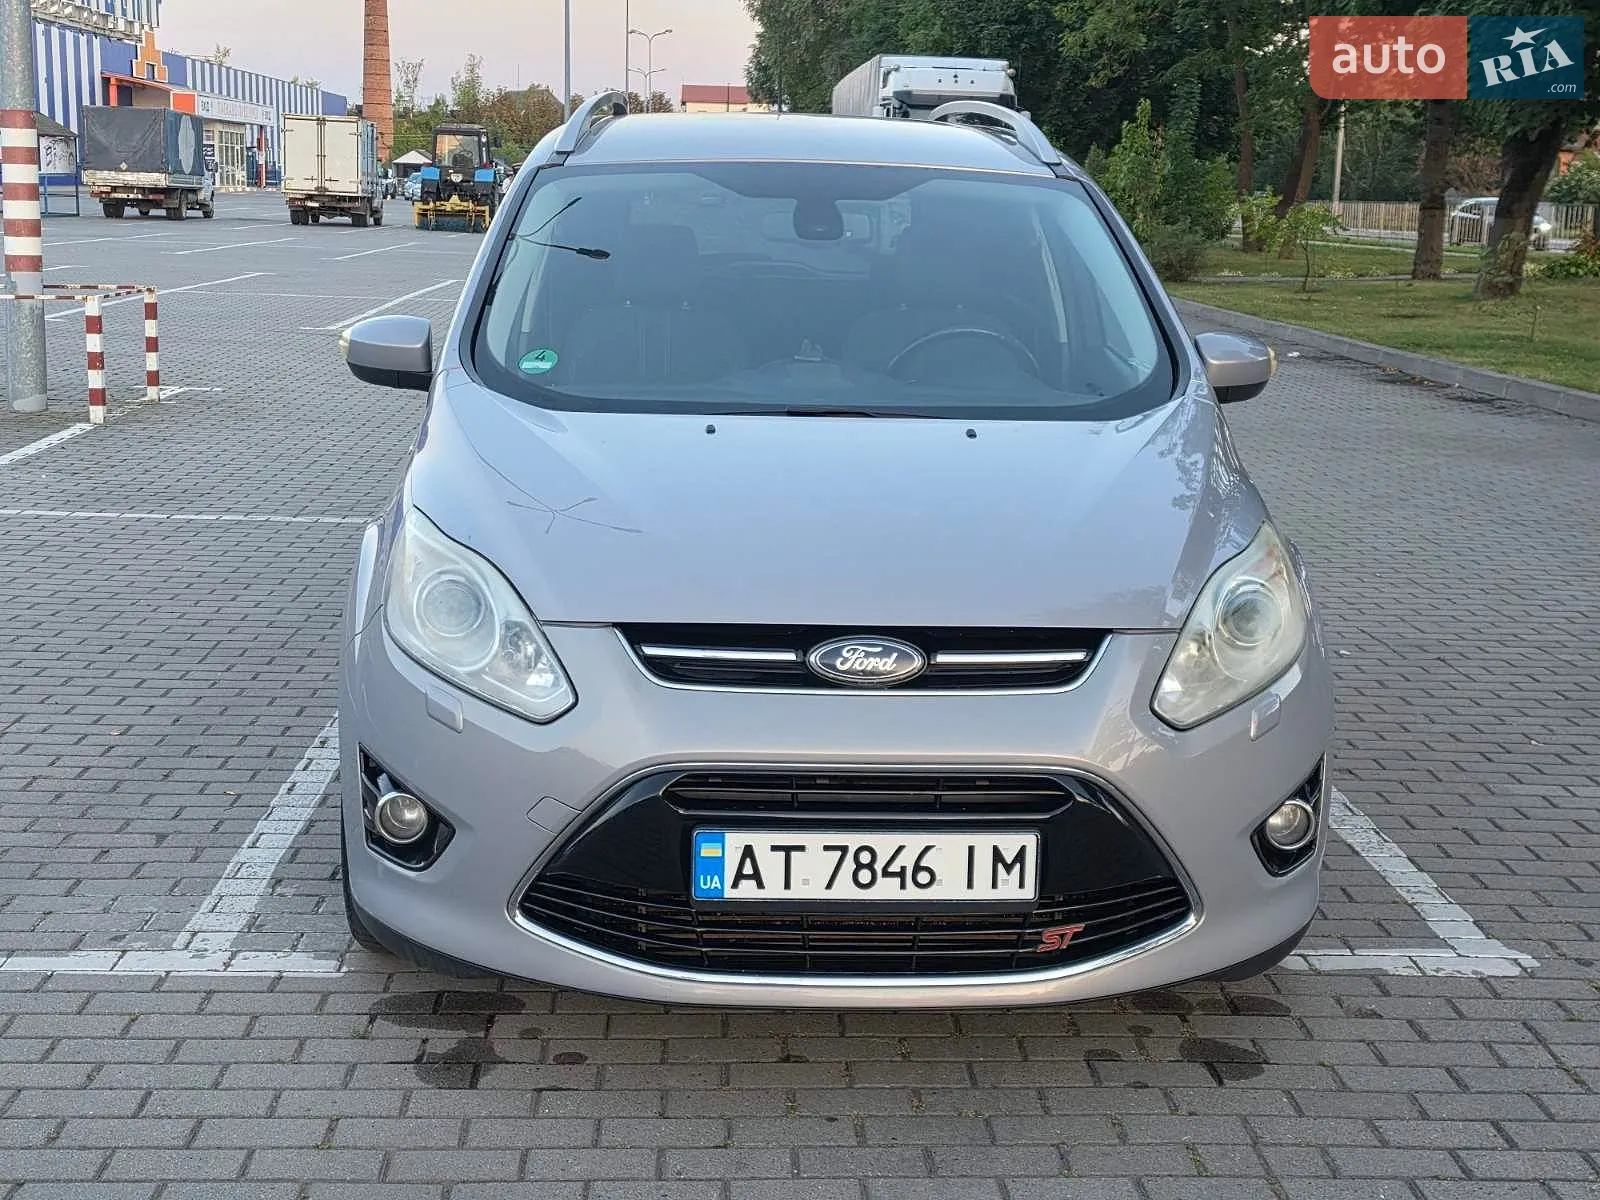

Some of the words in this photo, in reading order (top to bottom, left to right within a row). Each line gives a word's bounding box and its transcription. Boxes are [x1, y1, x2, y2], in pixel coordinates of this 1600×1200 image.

[535, 350, 546, 361] 4
[835, 645, 898, 671] Ford
[730, 844, 806, 890] AT
[822, 844, 937, 890] 7846
[966, 844, 1027, 890] IM
[700, 874, 722, 890] UA
[1036, 923, 1086, 953] ST
